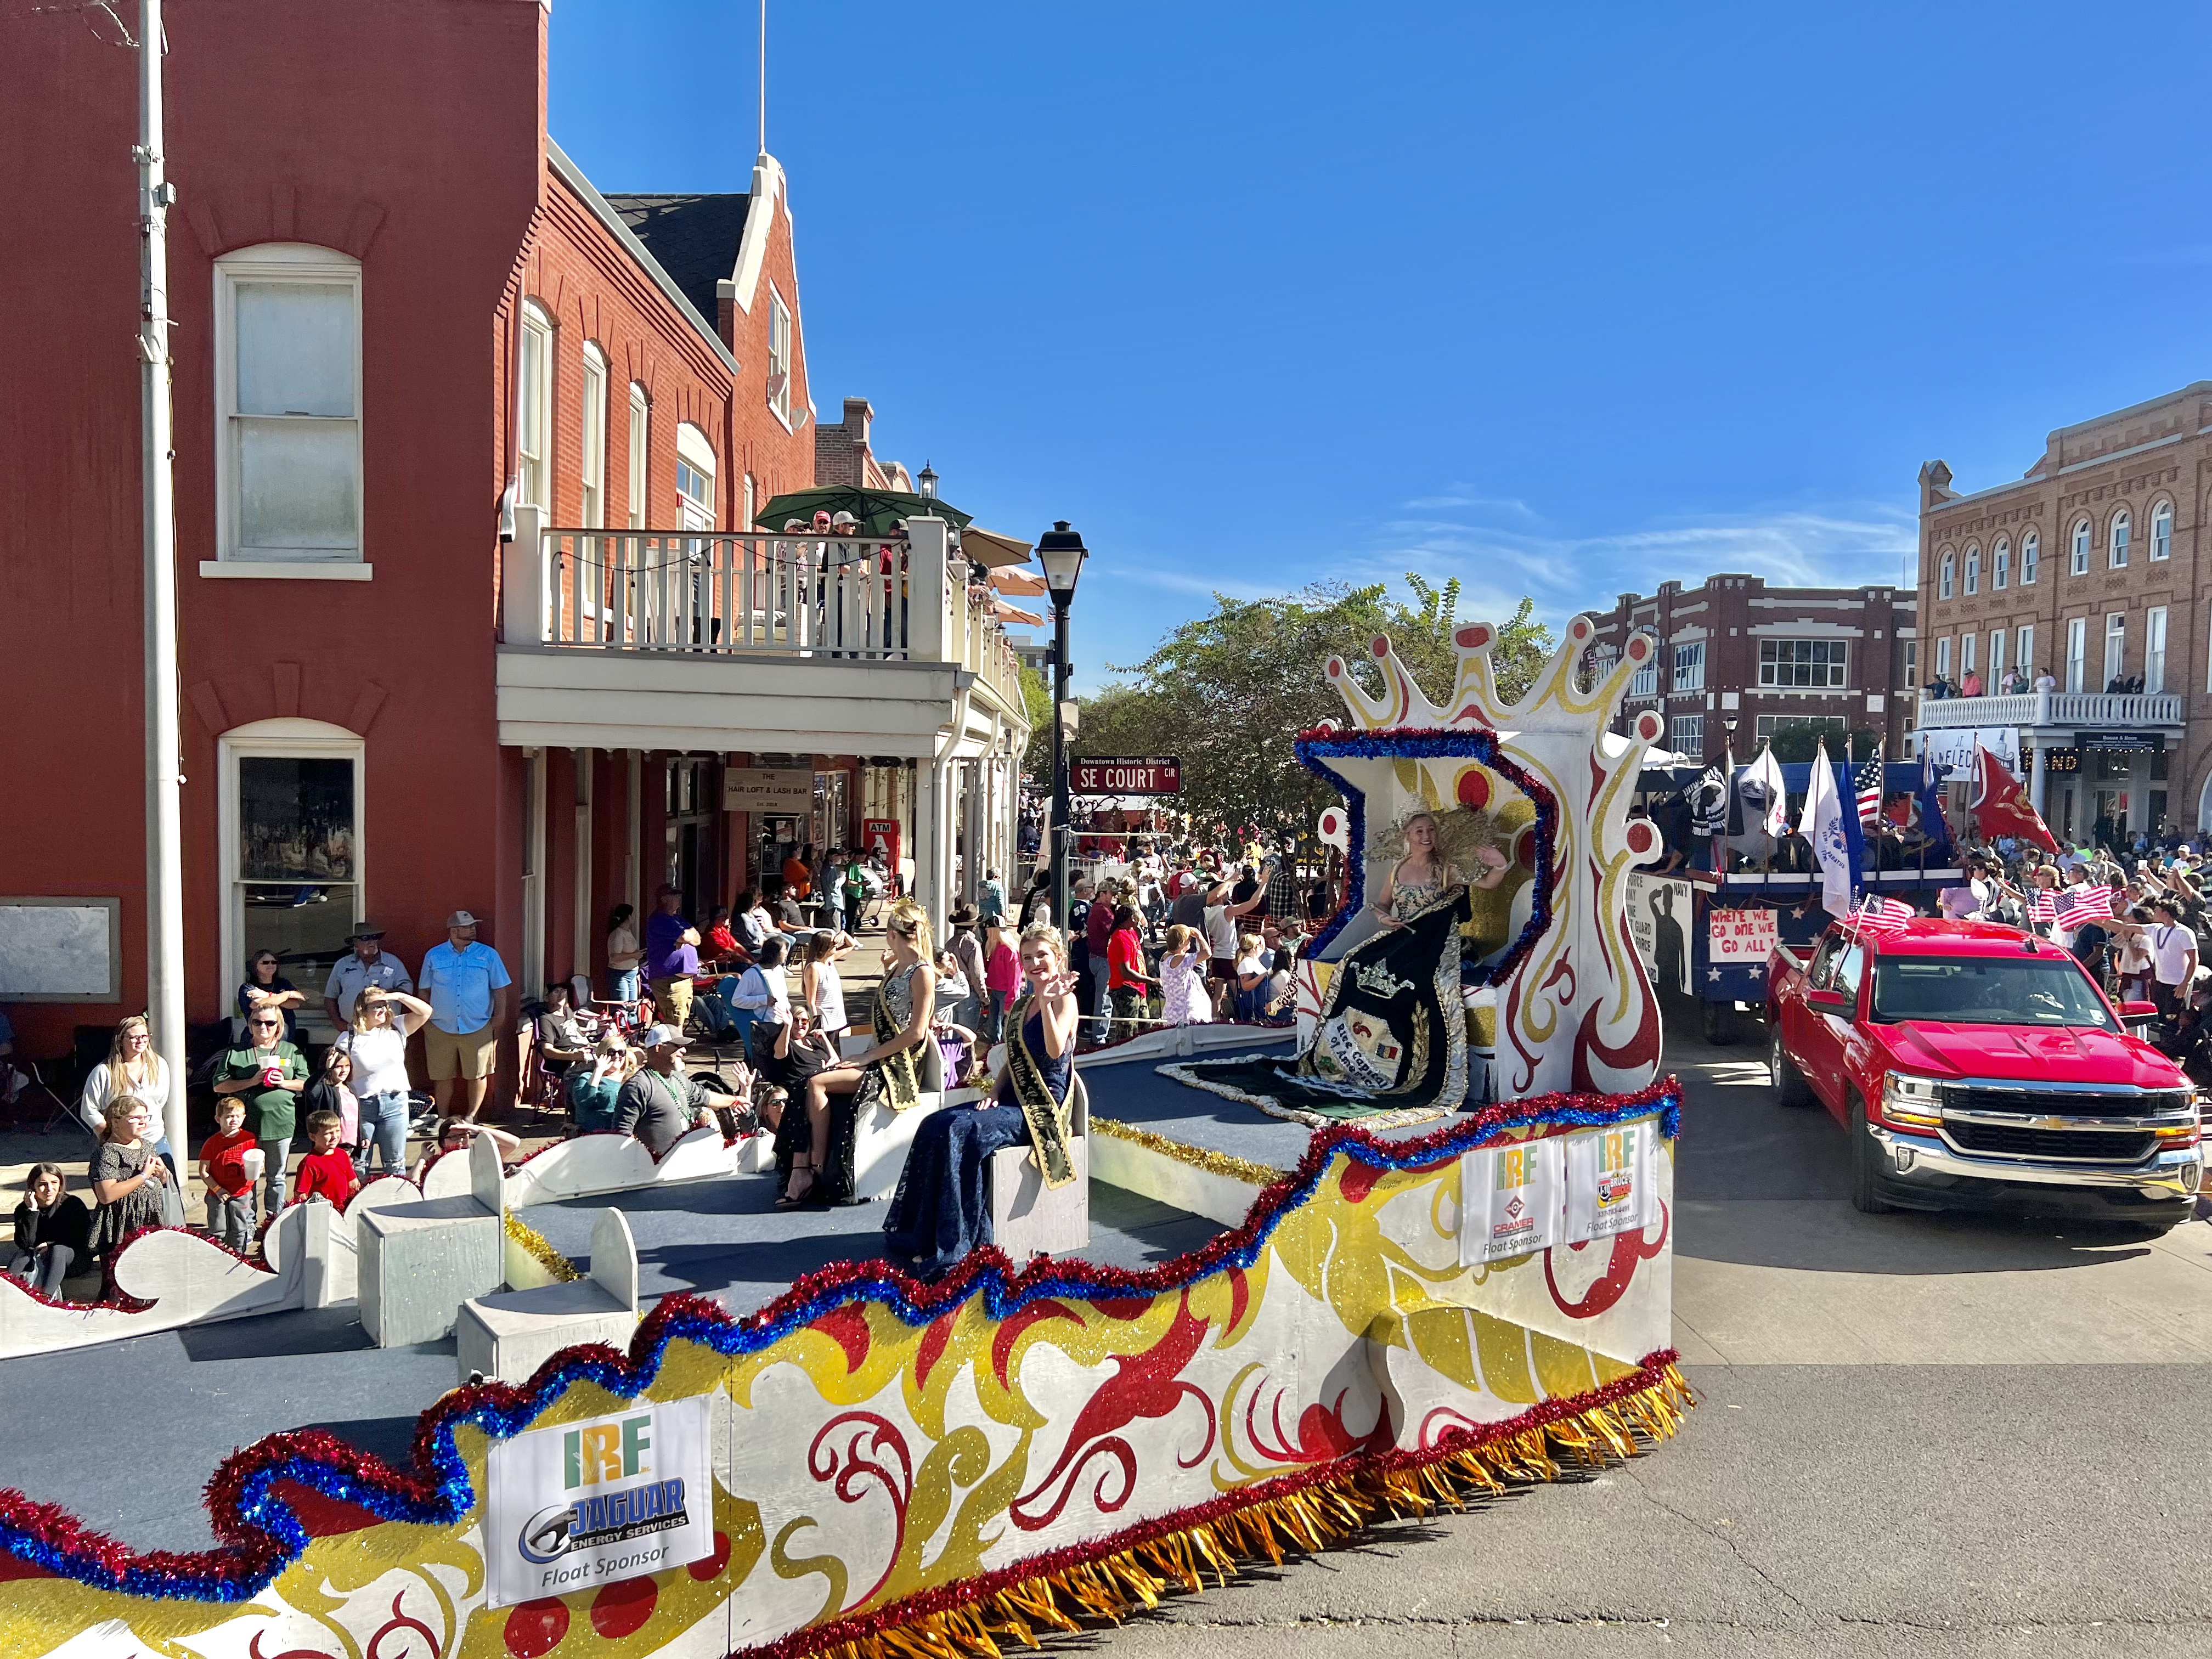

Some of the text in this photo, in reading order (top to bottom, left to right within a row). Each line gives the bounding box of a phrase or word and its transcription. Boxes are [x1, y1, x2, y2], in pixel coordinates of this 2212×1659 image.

[1080, 768, 1175, 788] SE COURT CIR
[871, 823, 890, 832] ATM
[1673, 882, 1688, 898] NAVY
[1752, 910, 1769, 921] WE
[1635, 921, 1651, 935] GUARD
[1711, 924, 1726, 938] GO
[1758, 922, 1775, 933] WE
[1635, 936, 1651, 952] FORCE
[1722, 939, 1738, 953] GO
[1598, 1130, 1635, 1173] IRF
[1496, 1144, 1538, 1191] IRF
[1493, 1217, 1534, 1233] CRAMER
[1586, 1213, 1638, 1233] Float Sponsor
[1483, 1234, 1543, 1255] Float Sponsor
[564, 1414, 651, 1491] IRF
[568, 1477, 685, 1537] JAGUAR
[570, 1516, 686, 1551] ENERGY SERVICES
[541, 1545, 669, 1587] Float Sponsor
